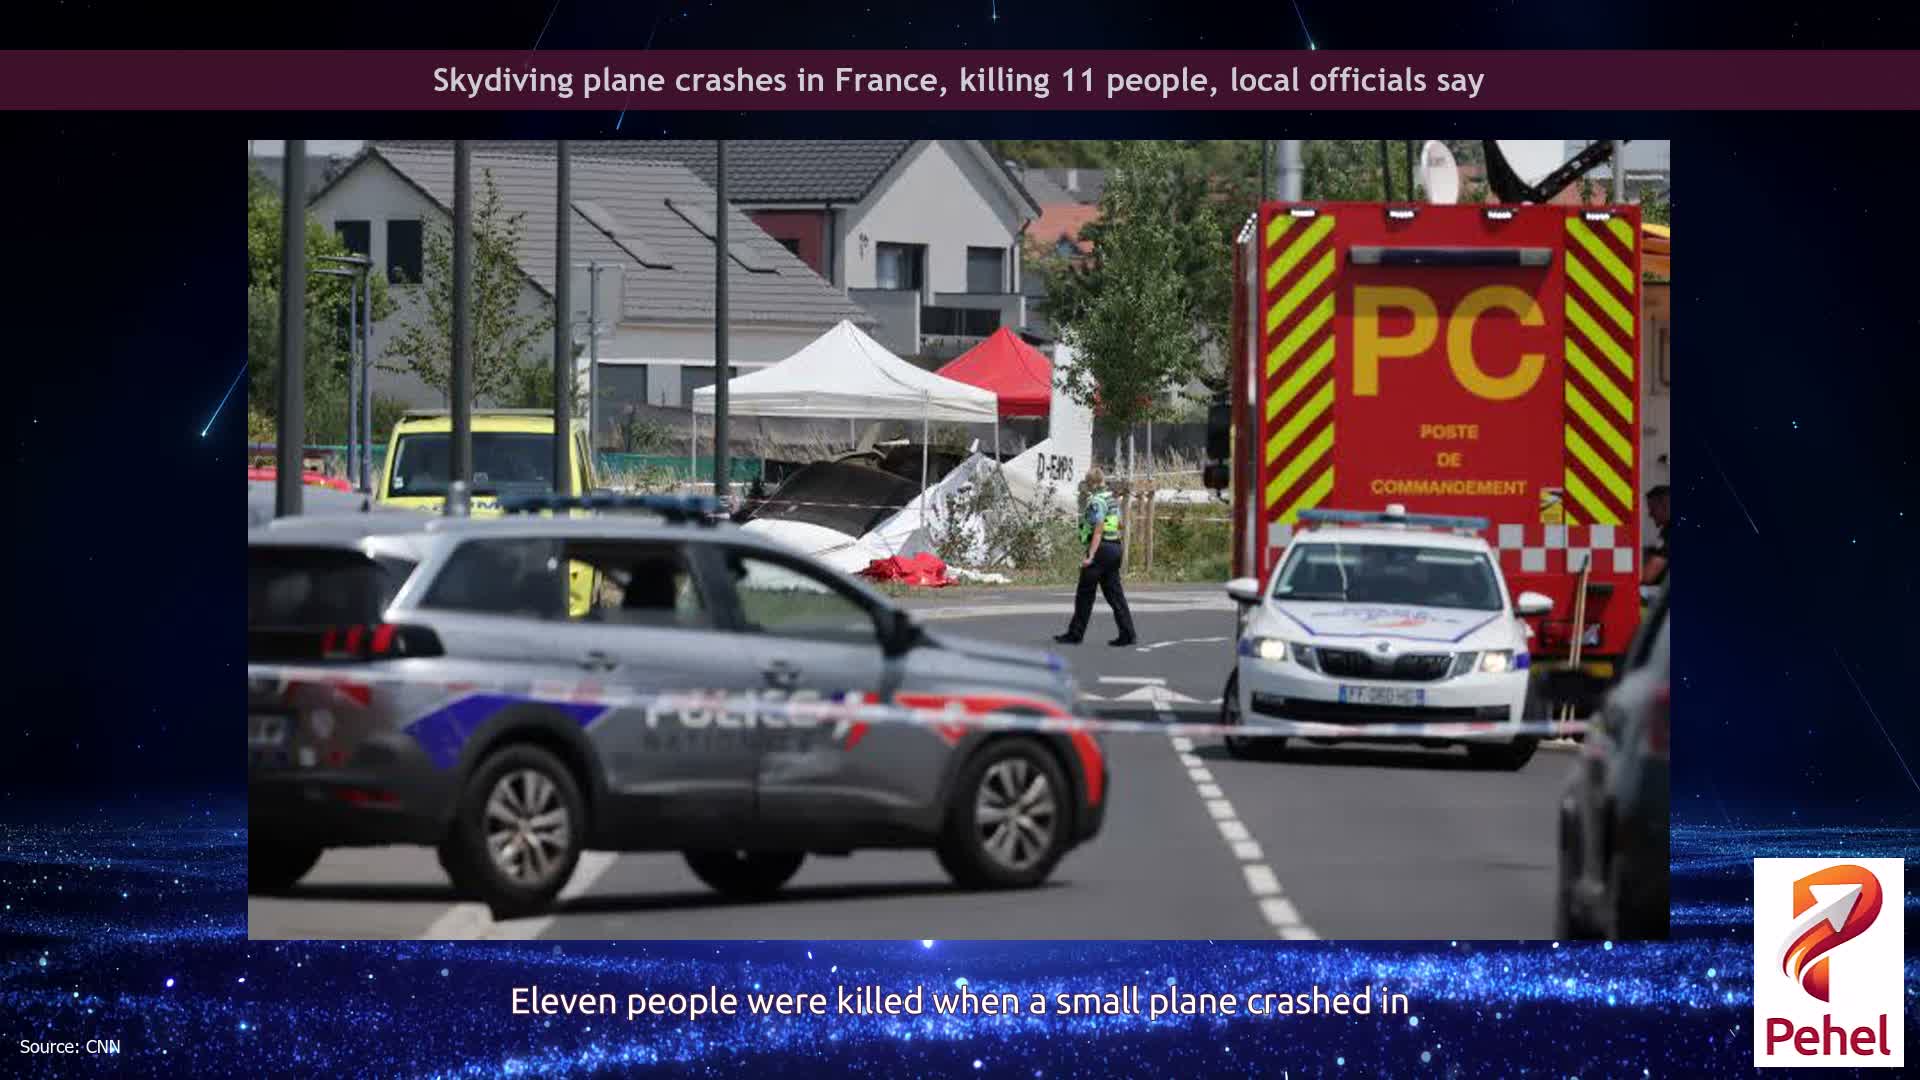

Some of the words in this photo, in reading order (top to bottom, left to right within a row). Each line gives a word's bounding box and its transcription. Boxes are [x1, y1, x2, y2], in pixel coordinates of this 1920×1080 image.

[1352, 287, 1546, 400] PC
[1420, 424, 1479, 439] POSTE
[1436, 452, 1462, 468] DE
[1371, 479, 1528, 496] COMMANDEMENT
